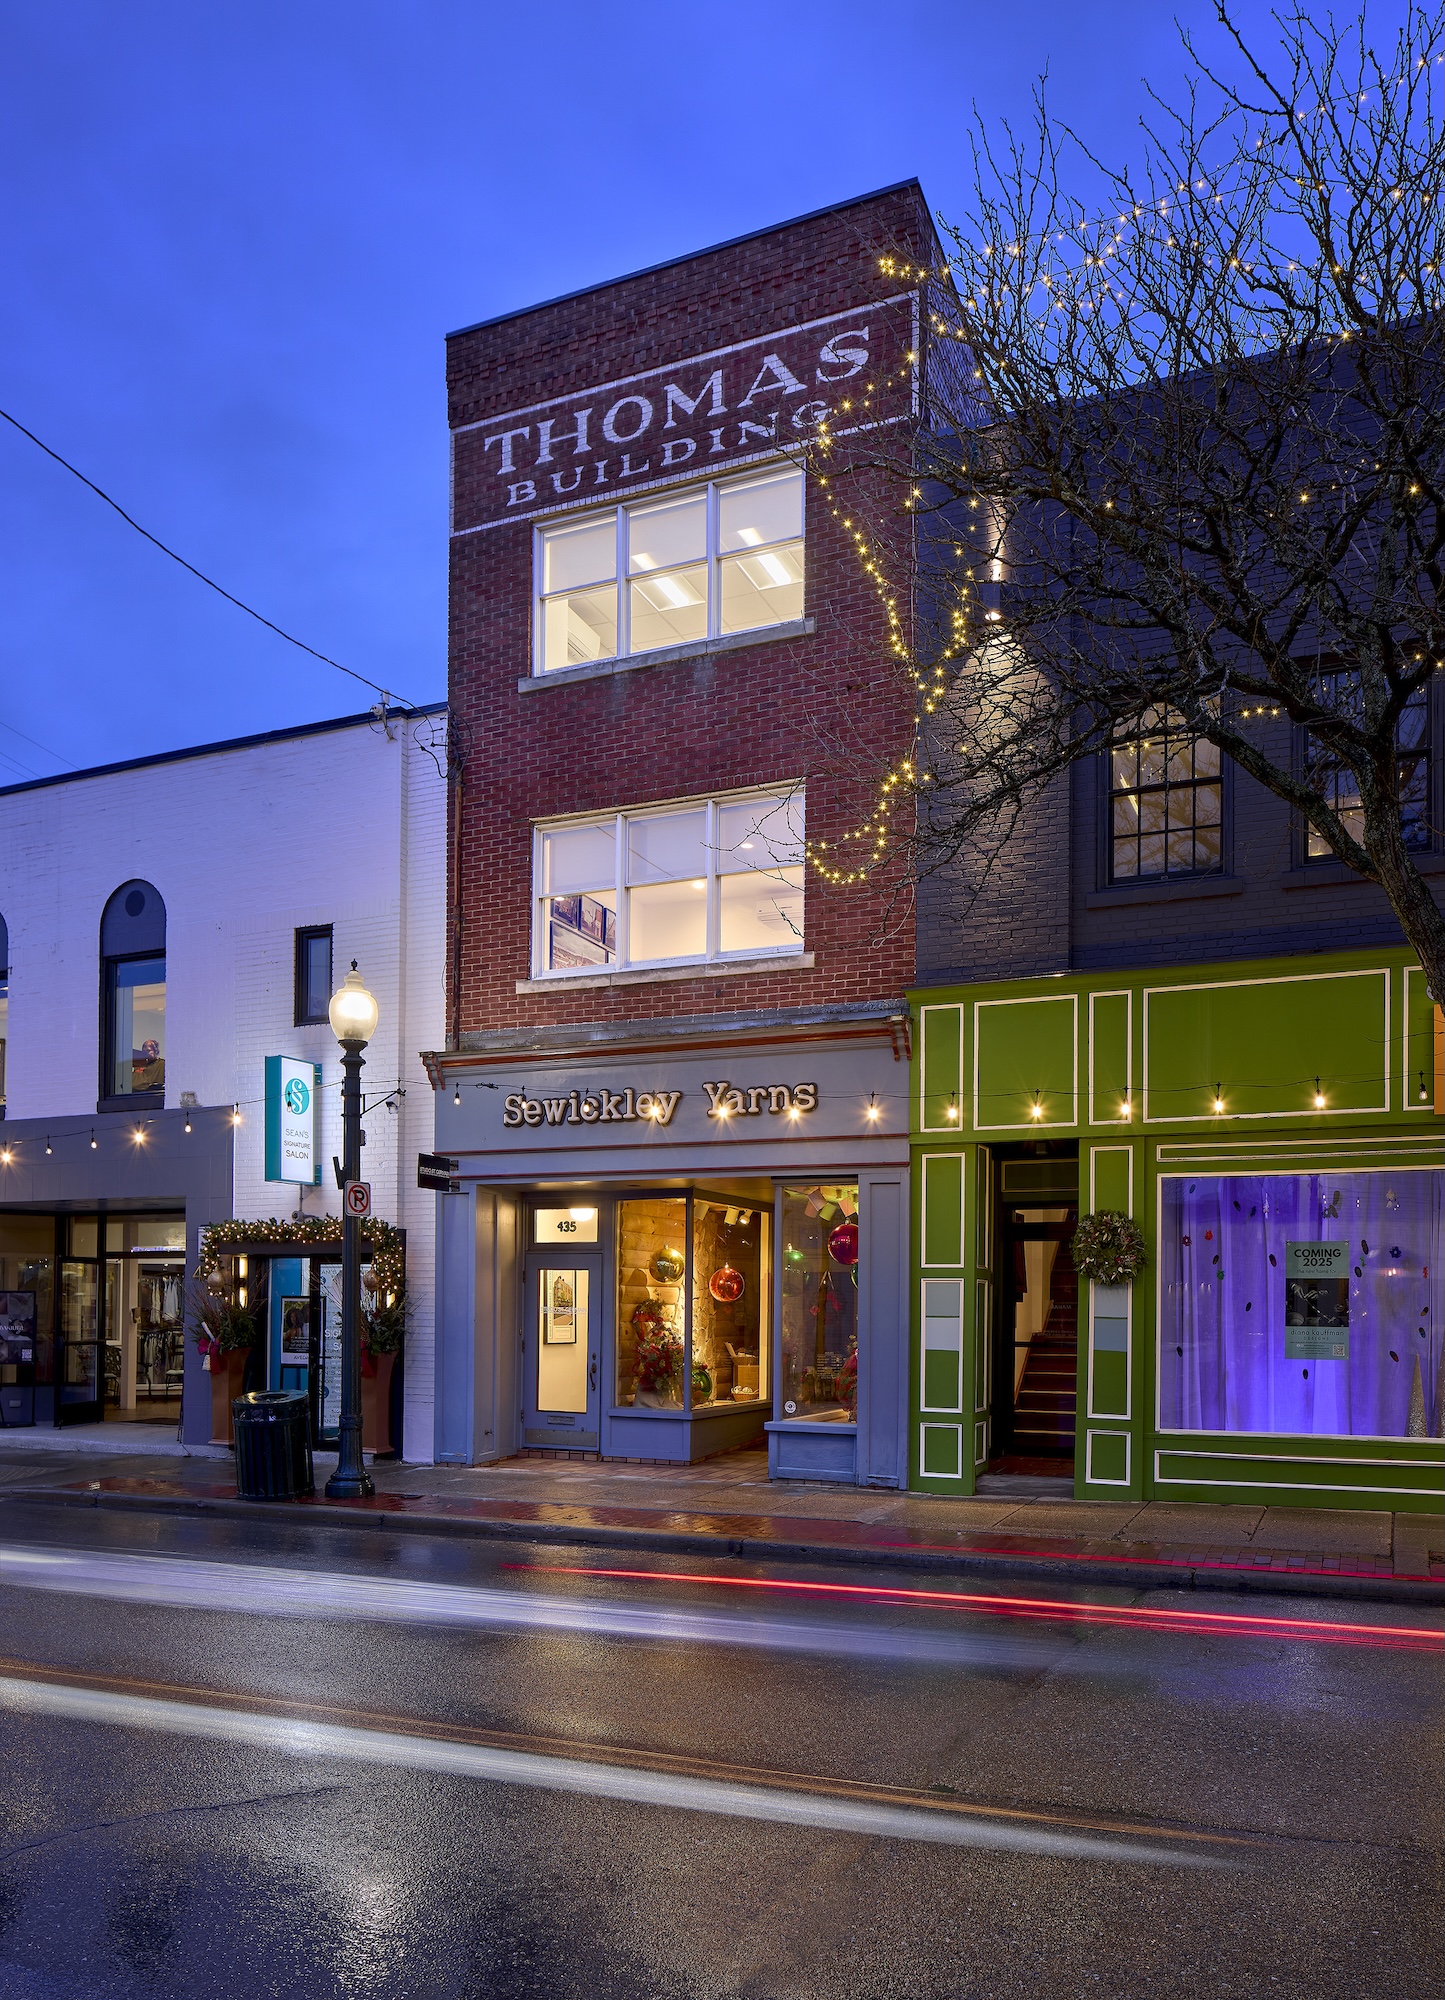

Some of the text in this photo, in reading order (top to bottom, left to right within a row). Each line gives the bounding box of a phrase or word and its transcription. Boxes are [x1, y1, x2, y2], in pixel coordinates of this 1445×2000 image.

[484, 326, 869, 476] THOMAS
[506, 400, 834, 507] BUILDING
[503, 1080, 819, 1127] Sewickley Yarns
[285, 1128, 310, 1139] SEAN'S
[283, 1139, 311, 1150] SIGNATURE
[285, 1149, 309, 1159] SALON
[556, 1220, 577, 1233] 435
[1294, 1248, 1341, 1258] COMING
[1303, 1257, 1333, 1267] 2025
